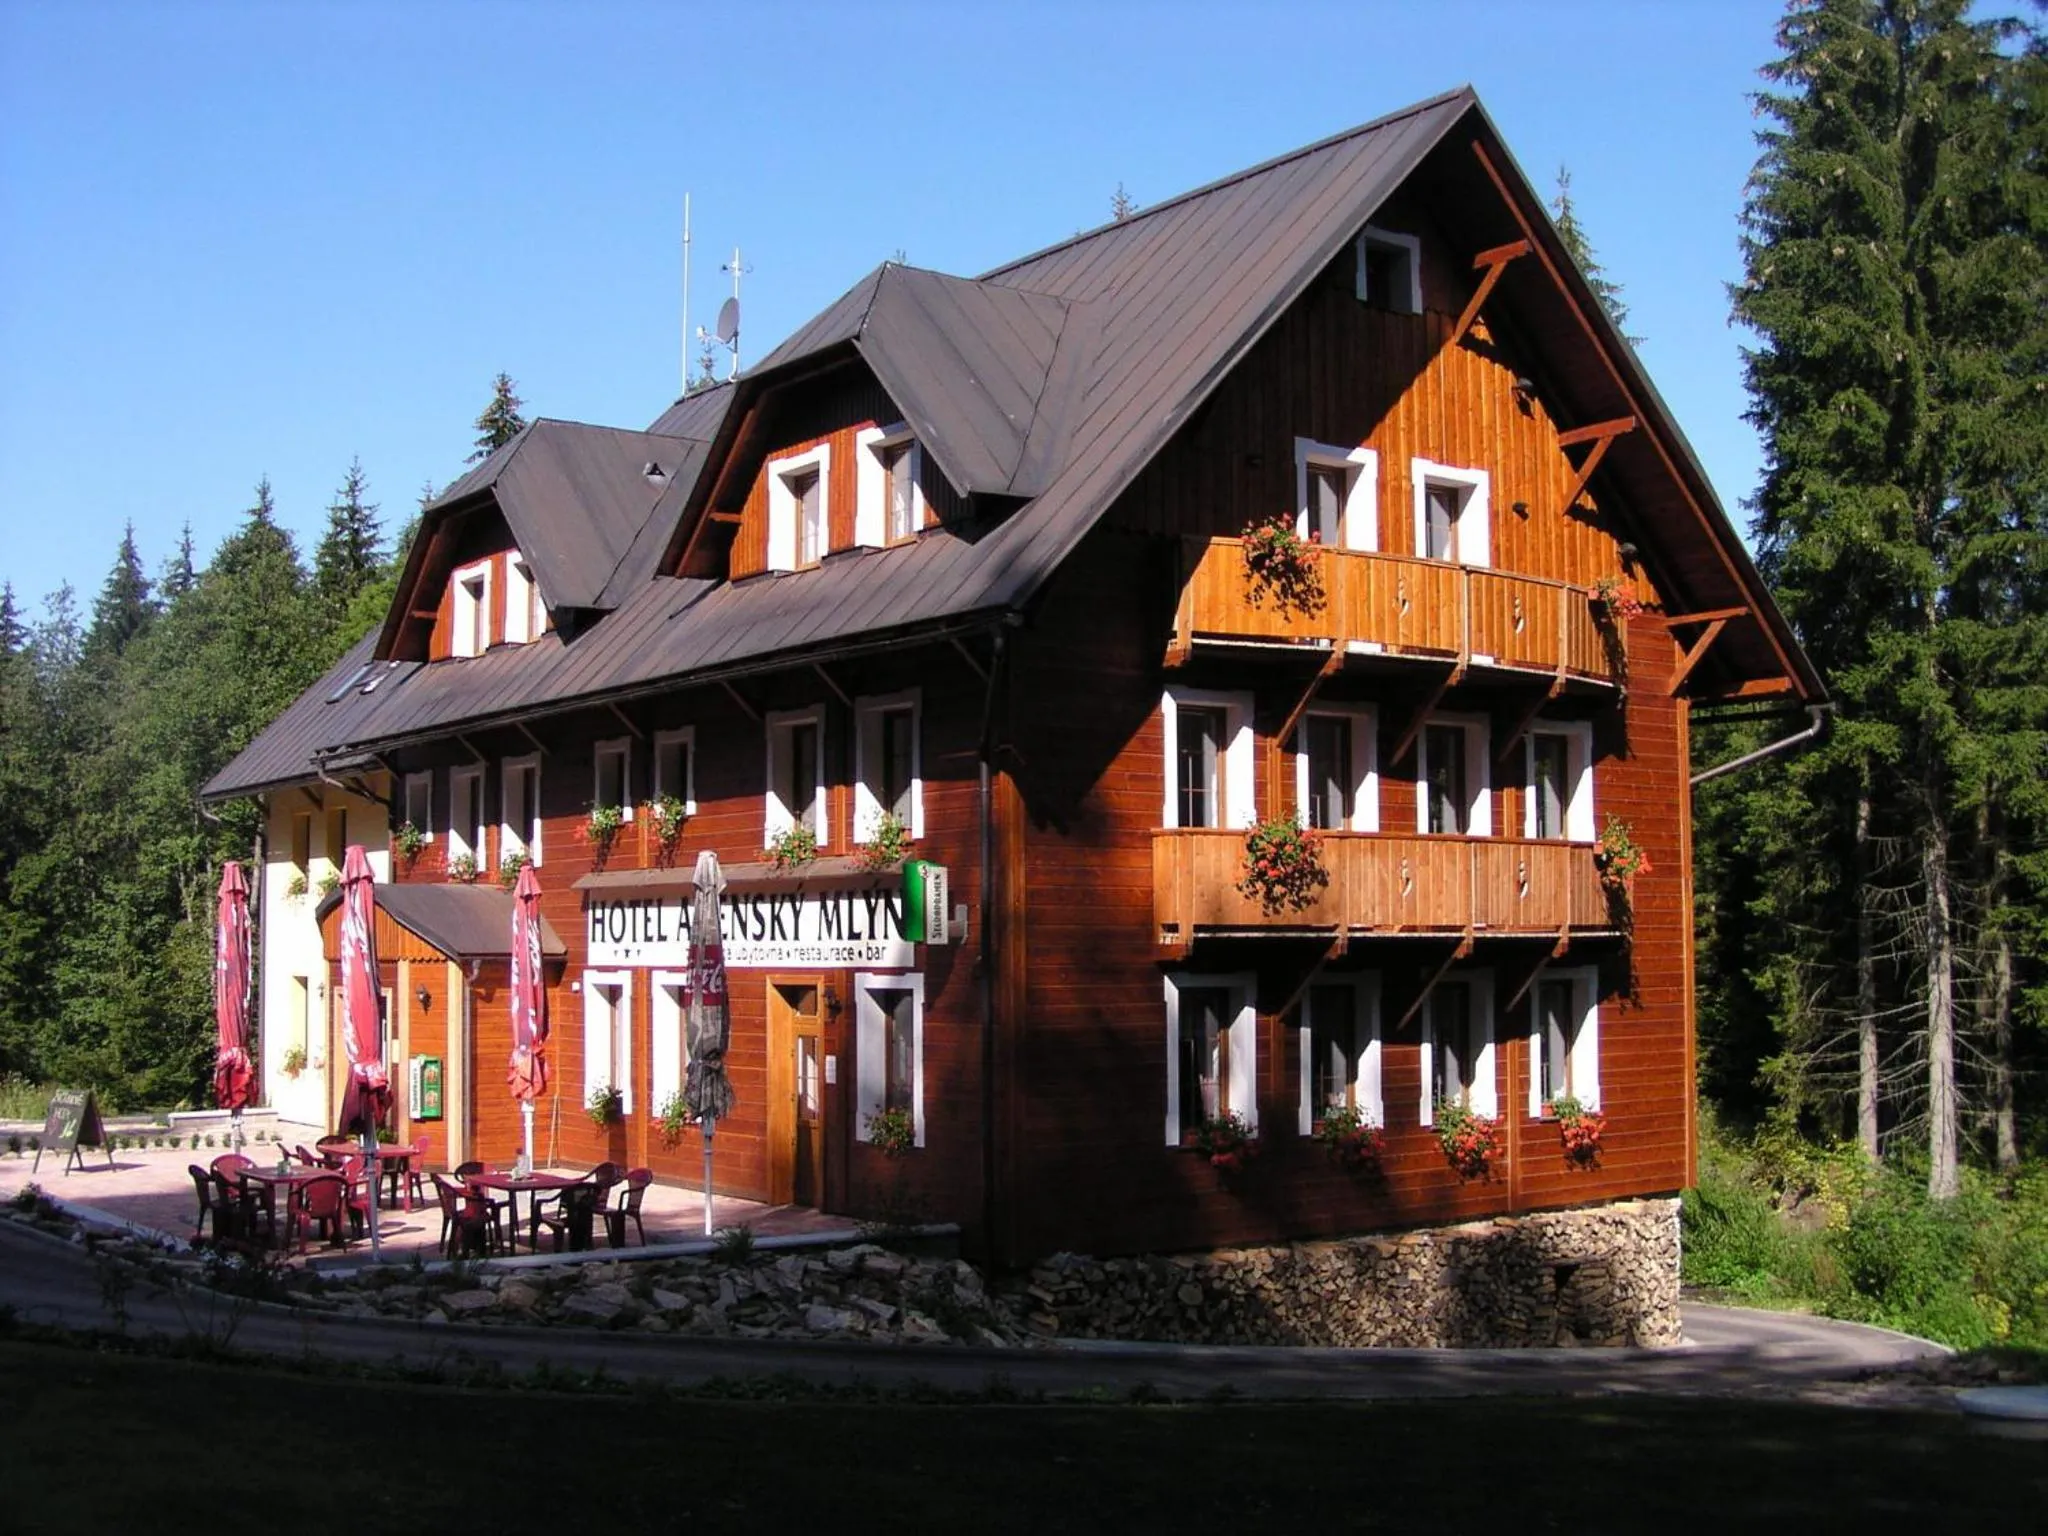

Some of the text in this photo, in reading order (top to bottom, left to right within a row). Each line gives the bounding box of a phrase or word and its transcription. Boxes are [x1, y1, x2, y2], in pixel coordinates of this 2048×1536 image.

[591, 878, 905, 943] HOTEL AENSKÝ MLÝN
[793, 945, 855, 961] restaurace
[866, 942, 886, 961] bar
